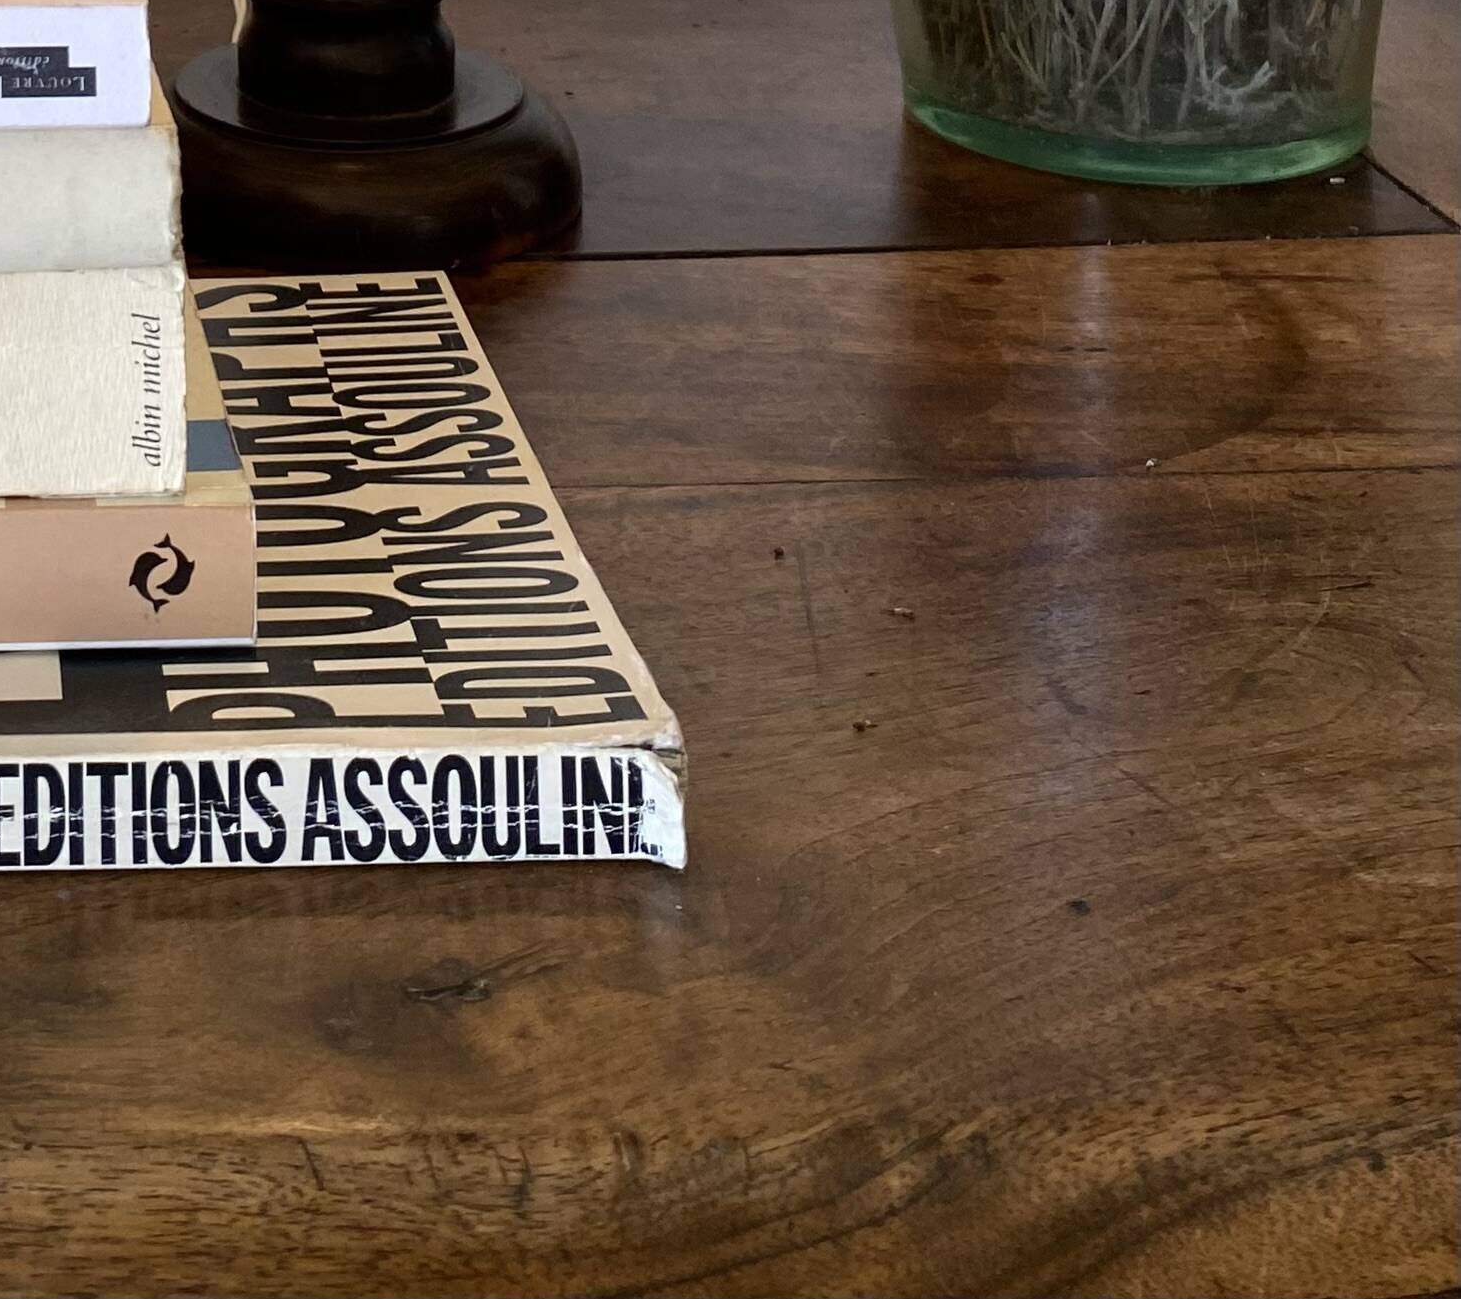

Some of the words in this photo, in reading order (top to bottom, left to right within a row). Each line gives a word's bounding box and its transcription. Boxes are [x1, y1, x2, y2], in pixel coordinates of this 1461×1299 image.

[130, 312, 161, 395] michel
[299, 277, 530, 485] ASSOULINE
[131, 404, 162, 467] albin
[381, 501, 649, 728] EDITIONS
